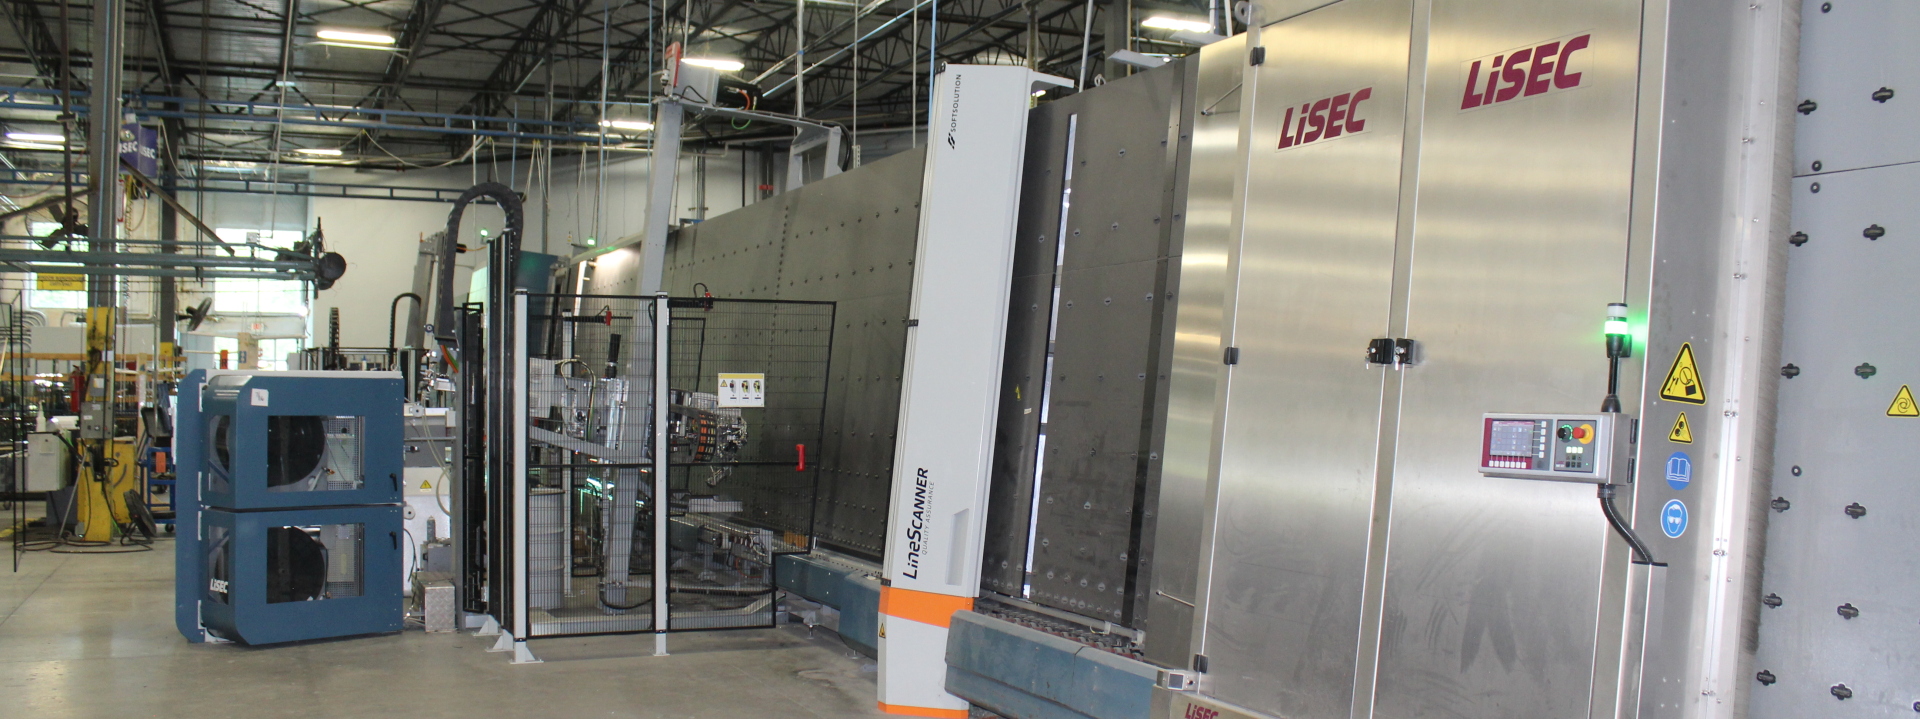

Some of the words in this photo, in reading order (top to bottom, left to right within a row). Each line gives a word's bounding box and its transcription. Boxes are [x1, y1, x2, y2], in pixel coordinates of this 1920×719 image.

[950, 74, 962, 132] SOFTSOLUTION
[924, 481, 935, 524] ASSURANCE
[921, 524, 930, 556] QUALITY
